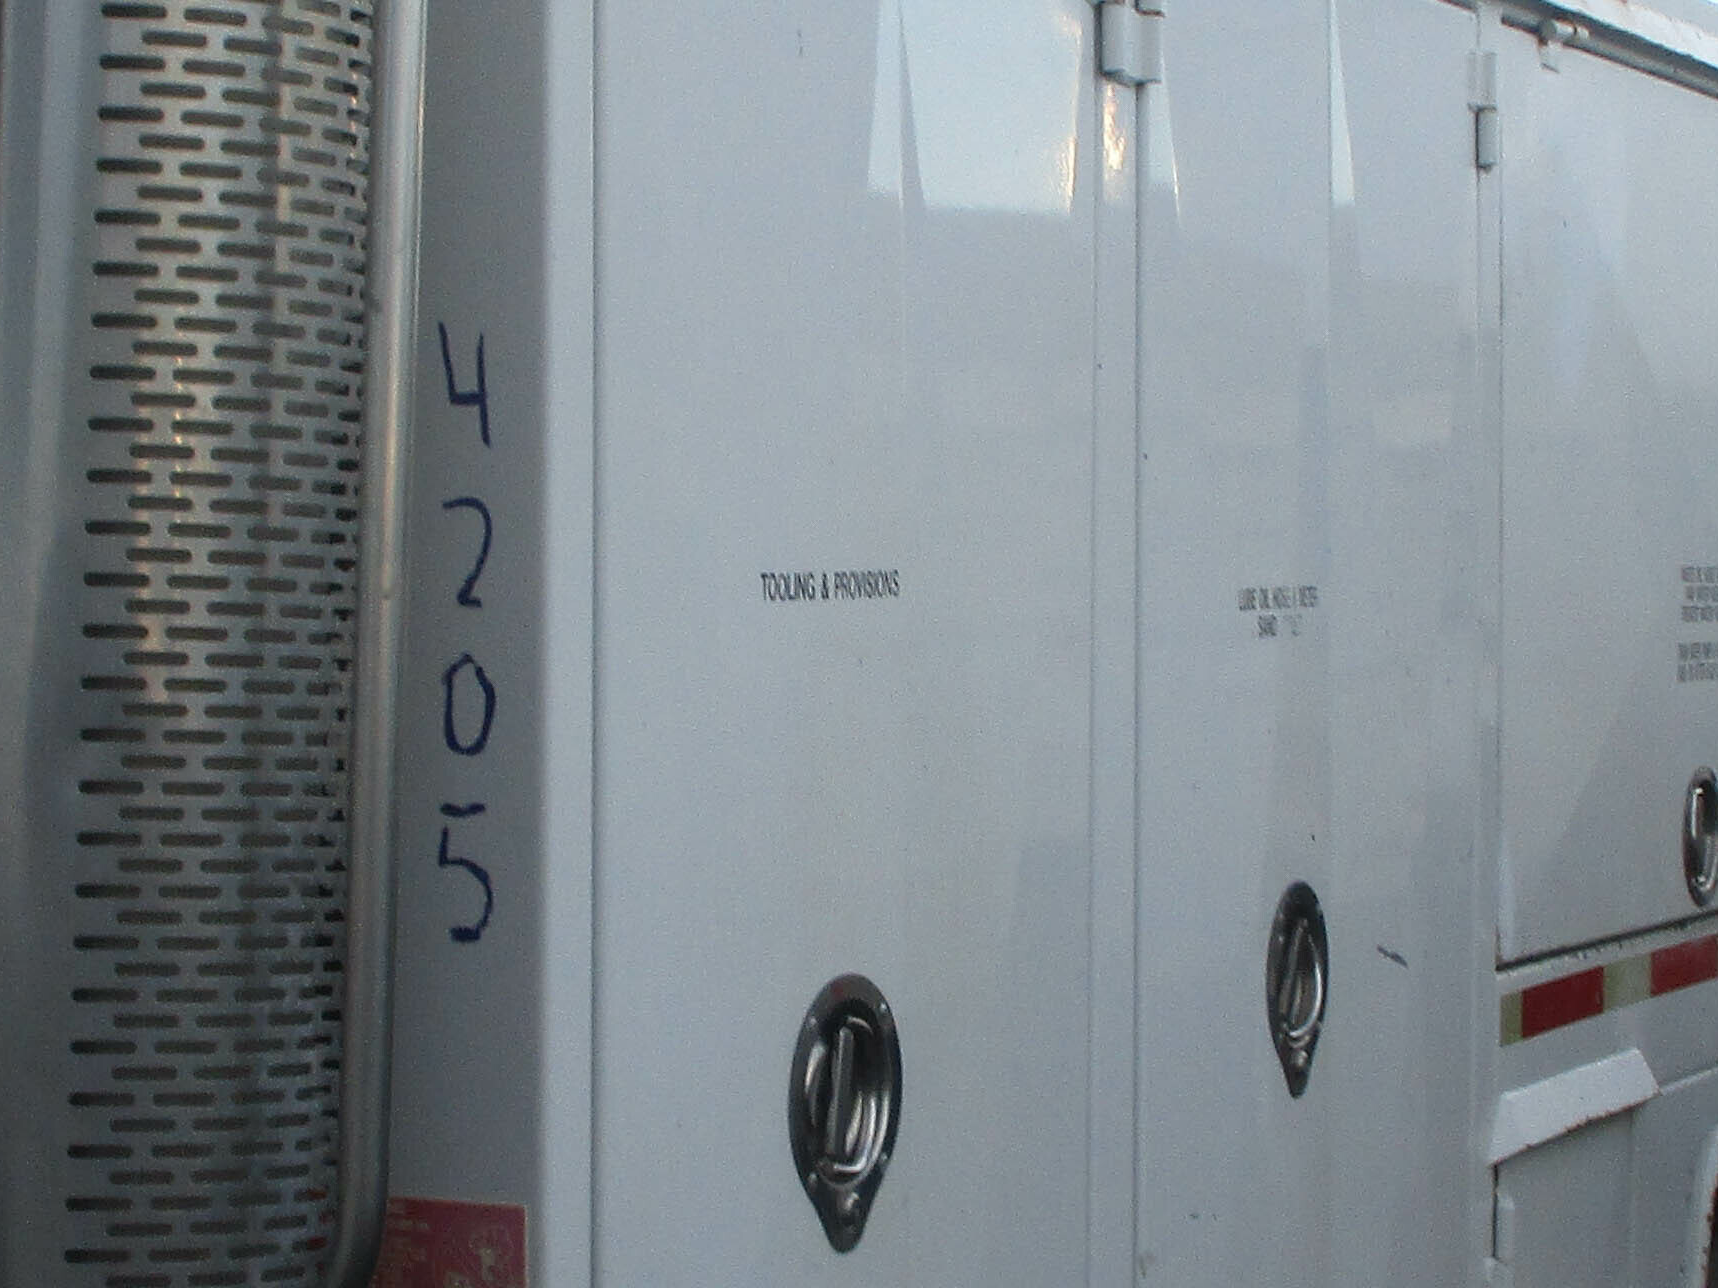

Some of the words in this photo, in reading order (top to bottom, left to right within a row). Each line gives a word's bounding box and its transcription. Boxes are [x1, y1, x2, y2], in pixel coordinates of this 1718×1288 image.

[761, 571, 816, 601] TOOLING
[821, 571, 829, 600] &
[834, 568, 900, 599] PROVISIONS
